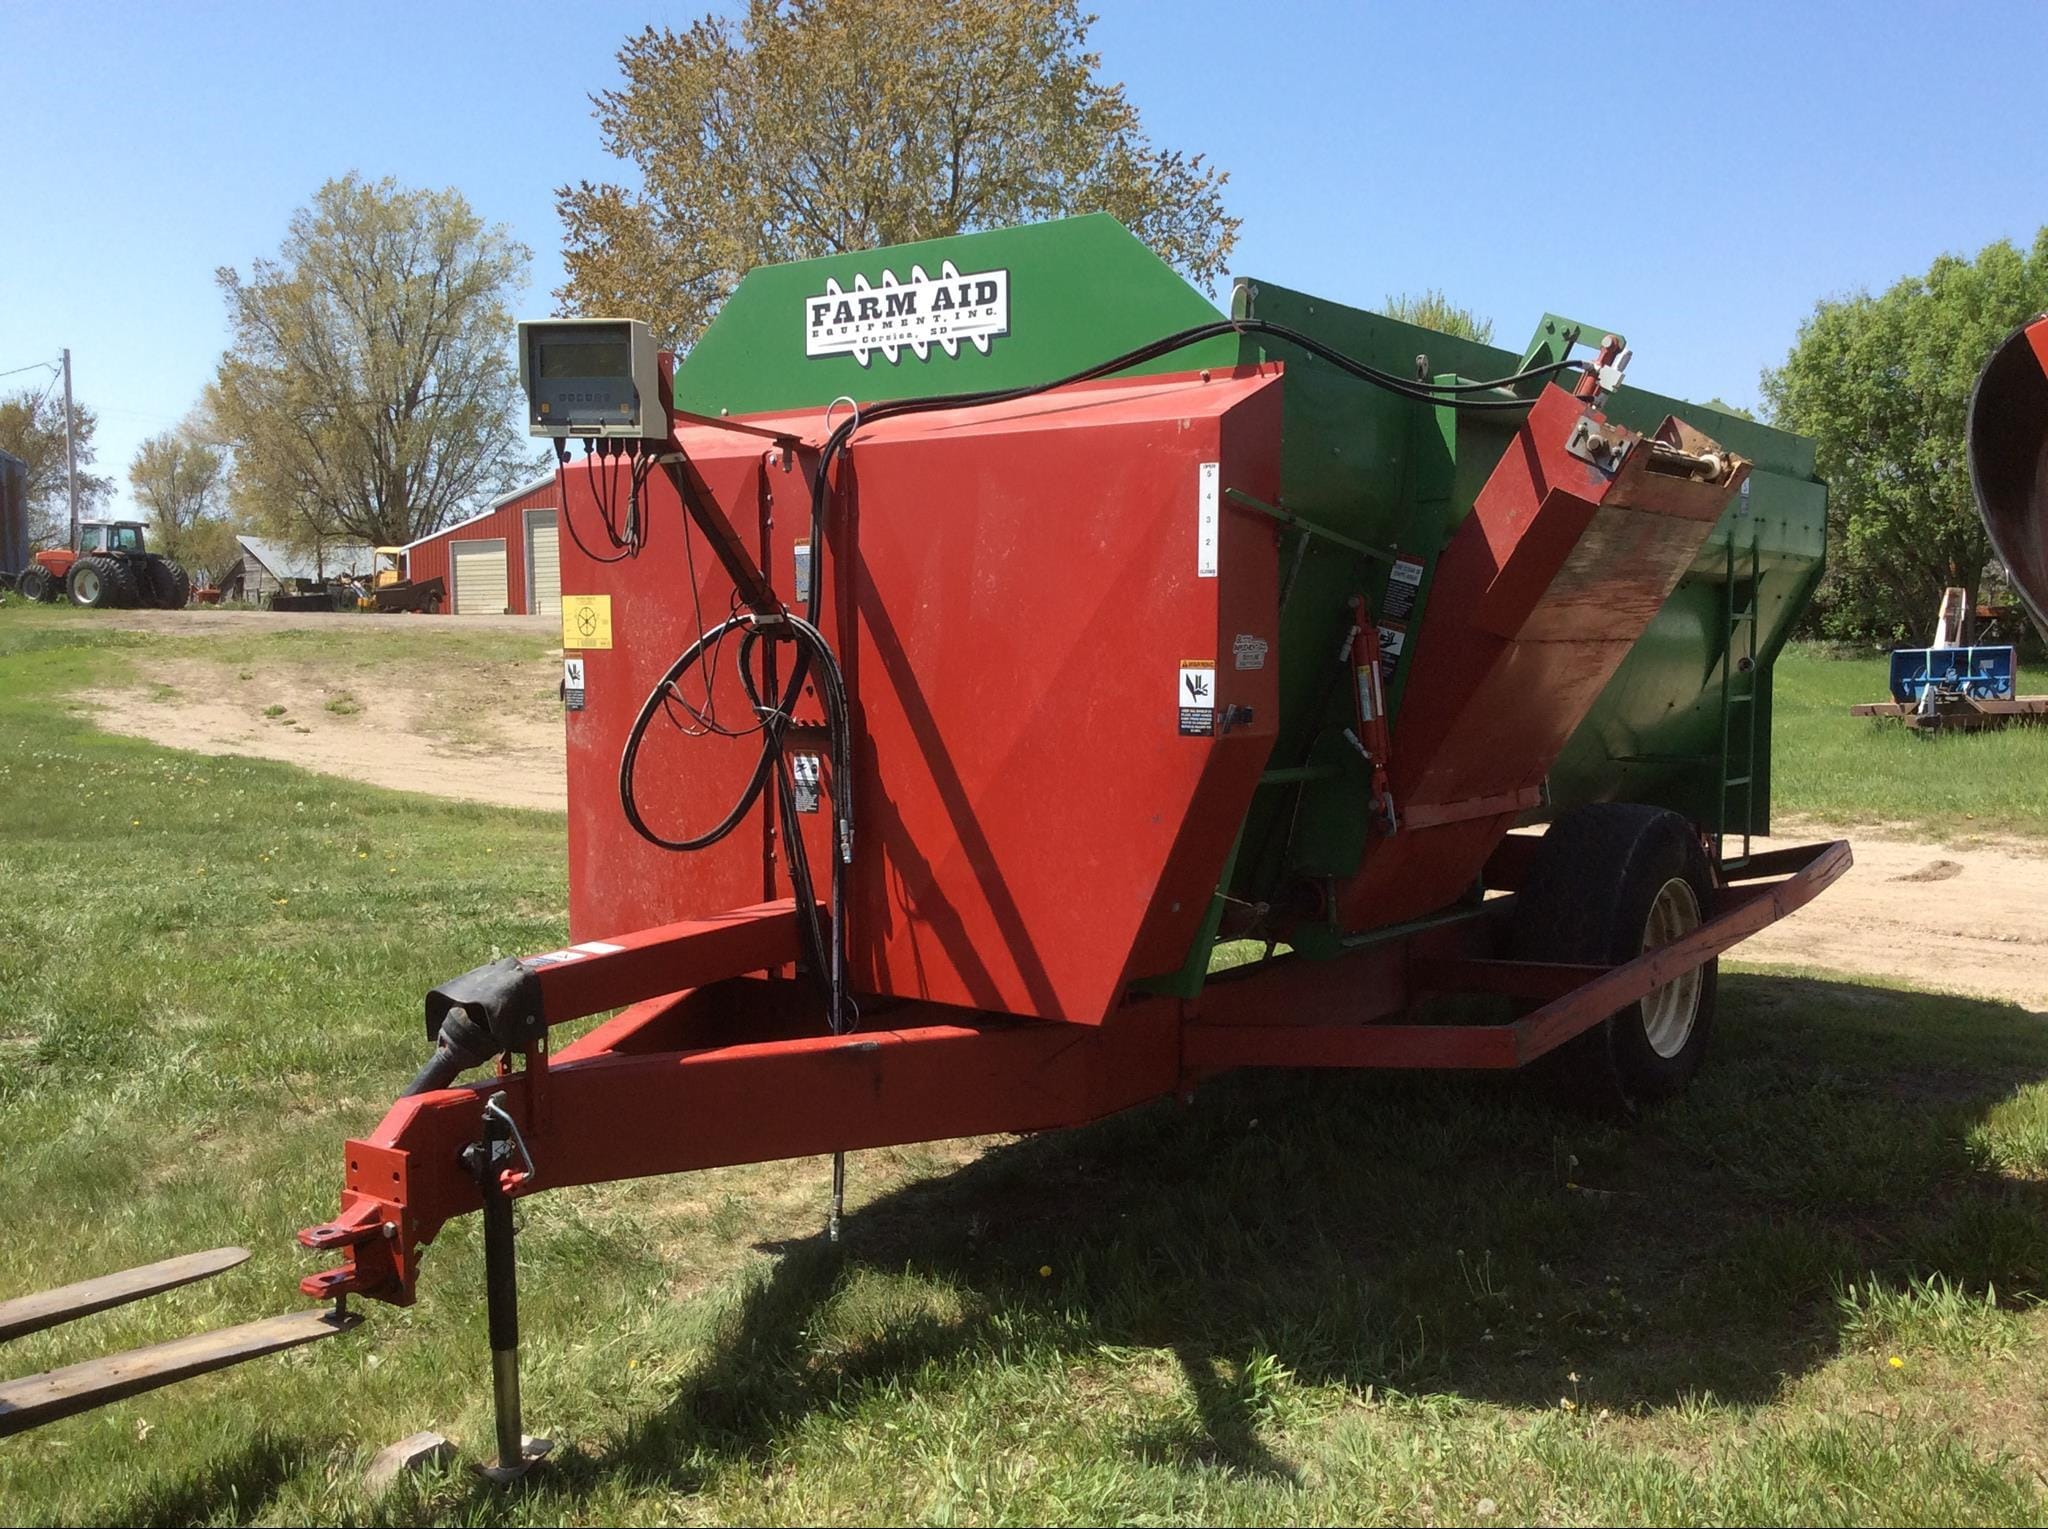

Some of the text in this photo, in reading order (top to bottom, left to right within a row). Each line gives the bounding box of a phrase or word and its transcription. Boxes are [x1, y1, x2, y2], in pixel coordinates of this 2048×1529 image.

[812, 280, 998, 327] FARM AID
[954, 307, 998, 320] INC.
[930, 325, 948, 336] SD
